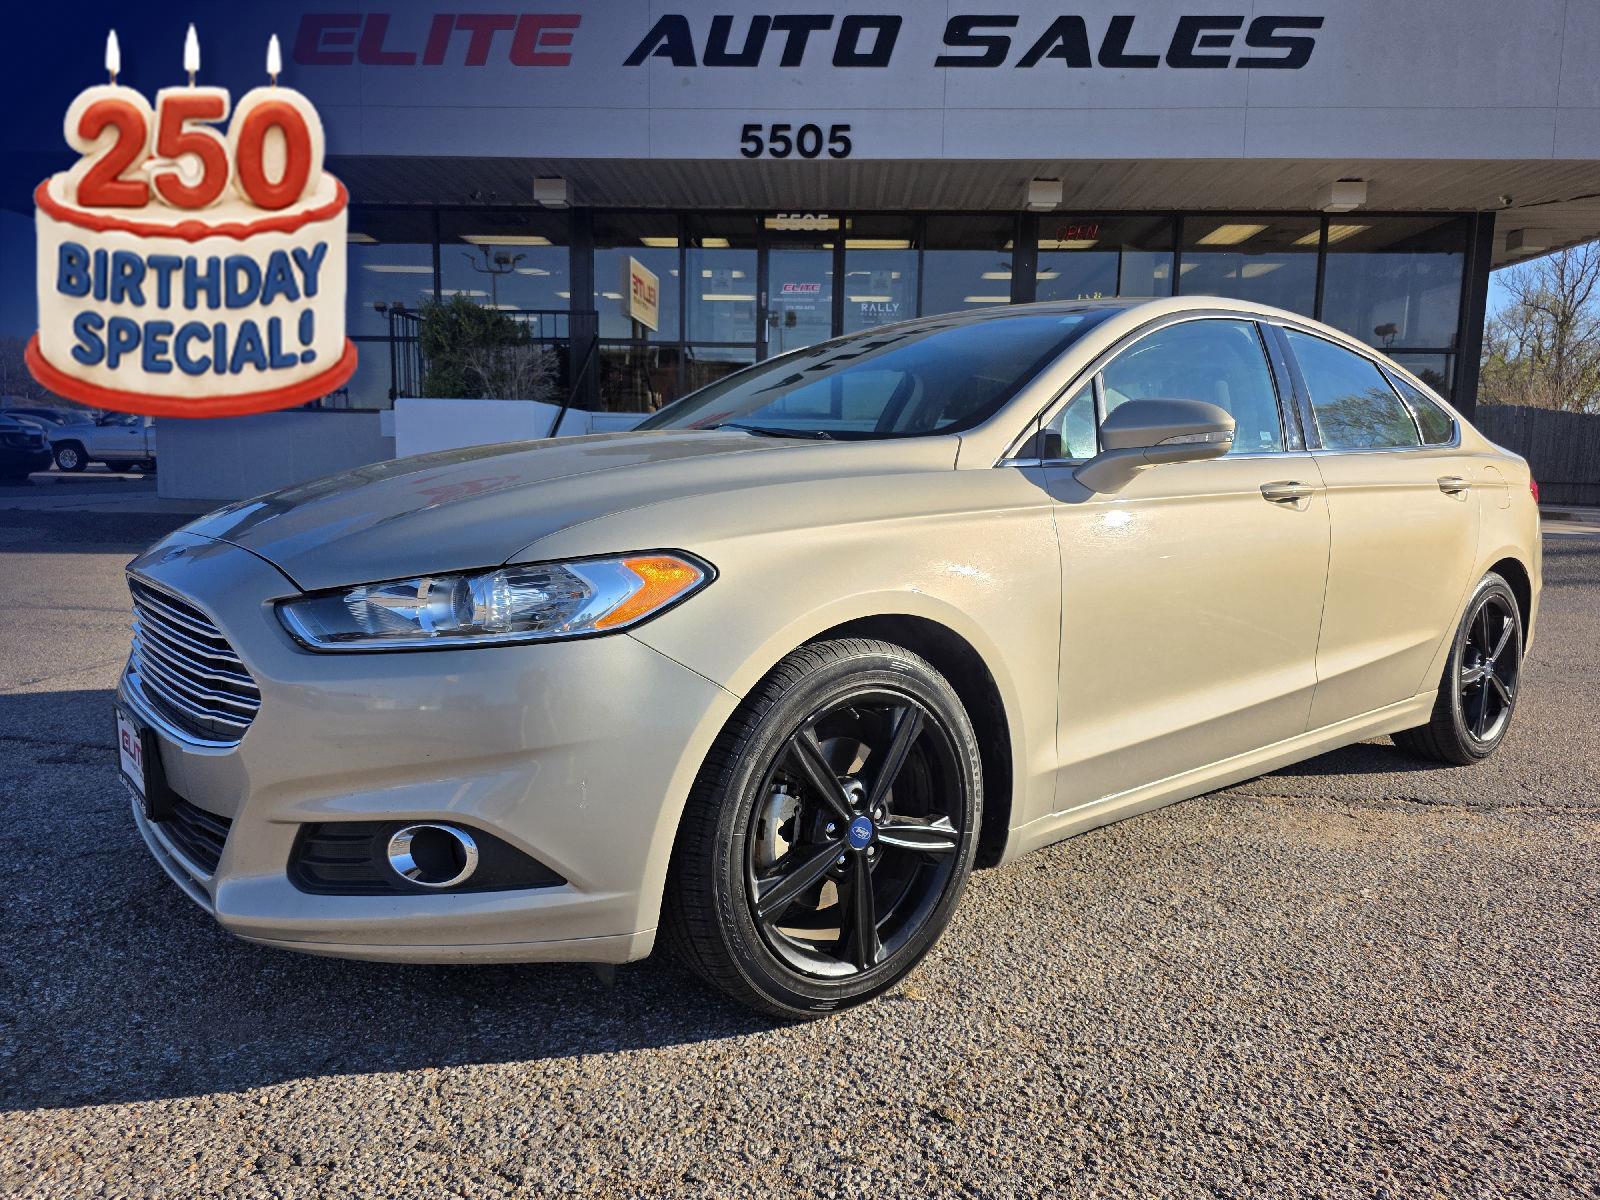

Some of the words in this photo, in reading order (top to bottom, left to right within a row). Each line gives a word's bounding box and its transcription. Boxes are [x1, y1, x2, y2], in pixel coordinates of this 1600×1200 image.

[292, 13, 581, 67] ELITE
[622, 14, 903, 67] AUTO
[933, 14, 1325, 69] SALES
[740, 123, 852, 159] 5505
[1056, 224, 1100, 242] OPEN
[783, 283, 821, 293] ELITE
[861, 303, 900, 312] RALLY
[121, 728, 142, 766] ELIT
